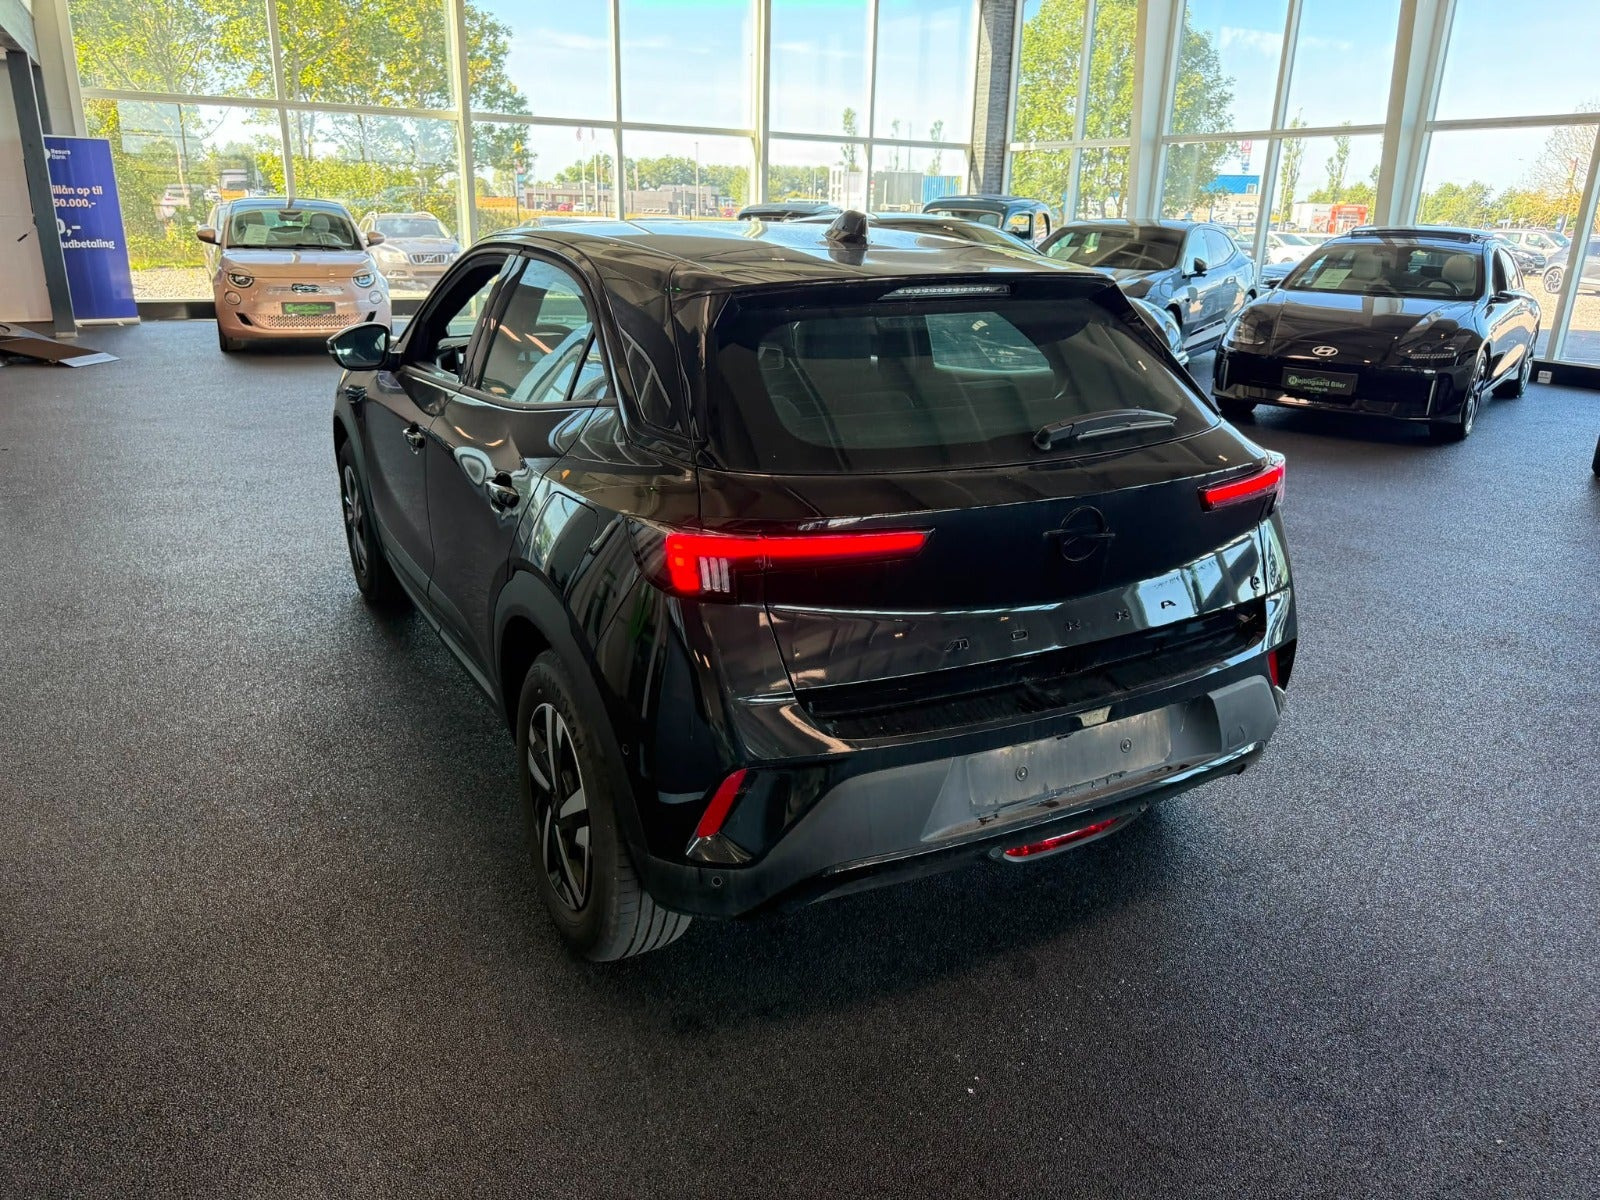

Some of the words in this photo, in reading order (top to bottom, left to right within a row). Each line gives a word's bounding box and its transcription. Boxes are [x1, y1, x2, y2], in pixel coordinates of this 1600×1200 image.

[52, 184, 74, 195] illån
[77, 187, 90, 197] op
[91, 185, 103, 195] til
[53, 198, 96, 208] 50.000,-
[61, 239, 115, 249] udbetaling
